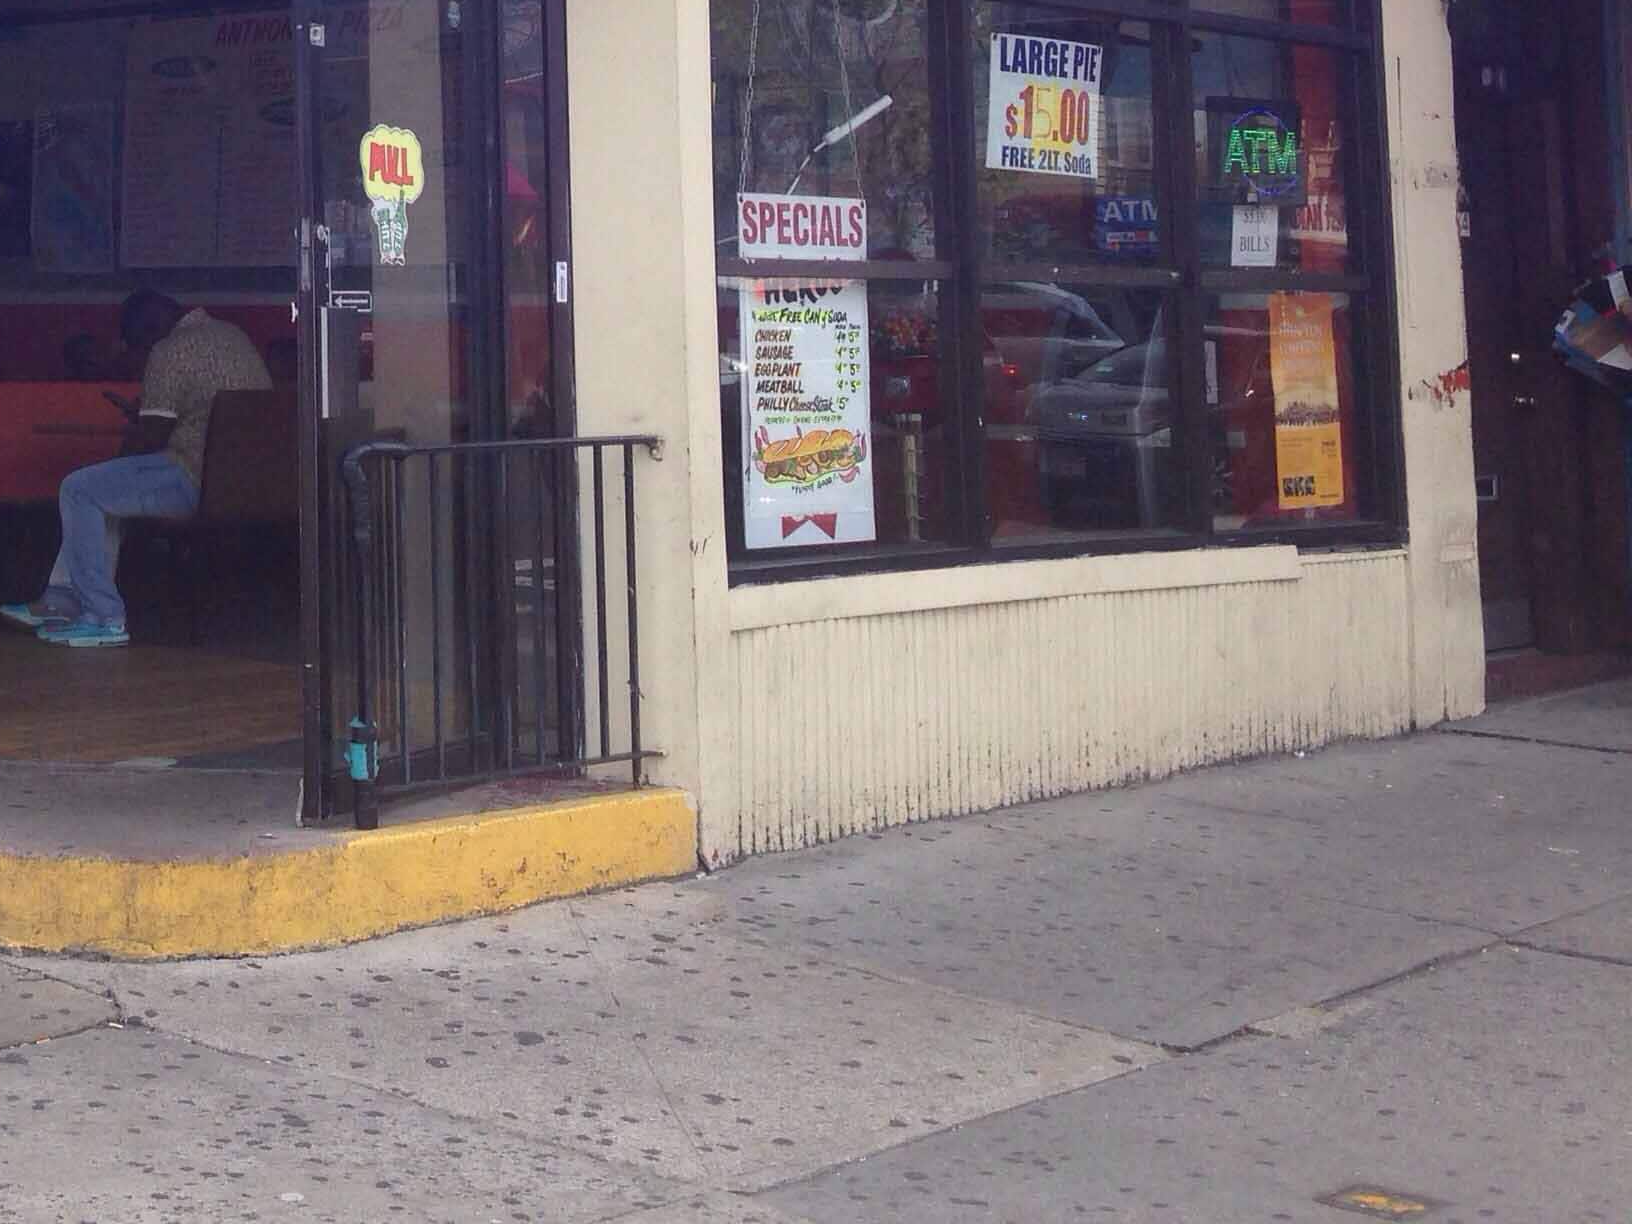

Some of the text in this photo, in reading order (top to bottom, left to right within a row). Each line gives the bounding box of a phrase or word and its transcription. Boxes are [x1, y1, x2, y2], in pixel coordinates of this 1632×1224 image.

[1000, 36, 1098, 82] LARGE PIE
[1005, 84, 1090, 146] $15.00
[369, 142, 414, 186] PULL
[1001, 145, 1036, 169] FREE
[1064, 152, 1092, 175] Soda
[1224, 129, 1296, 174] ATM
[742, 199, 864, 248] SPECIALS
[755, 330, 791, 342] CHICKEN
[755, 346, 794, 360] SAUSAGE
[755, 379, 805, 394] MEATBALL
[757, 397, 789, 412] PHILLY
